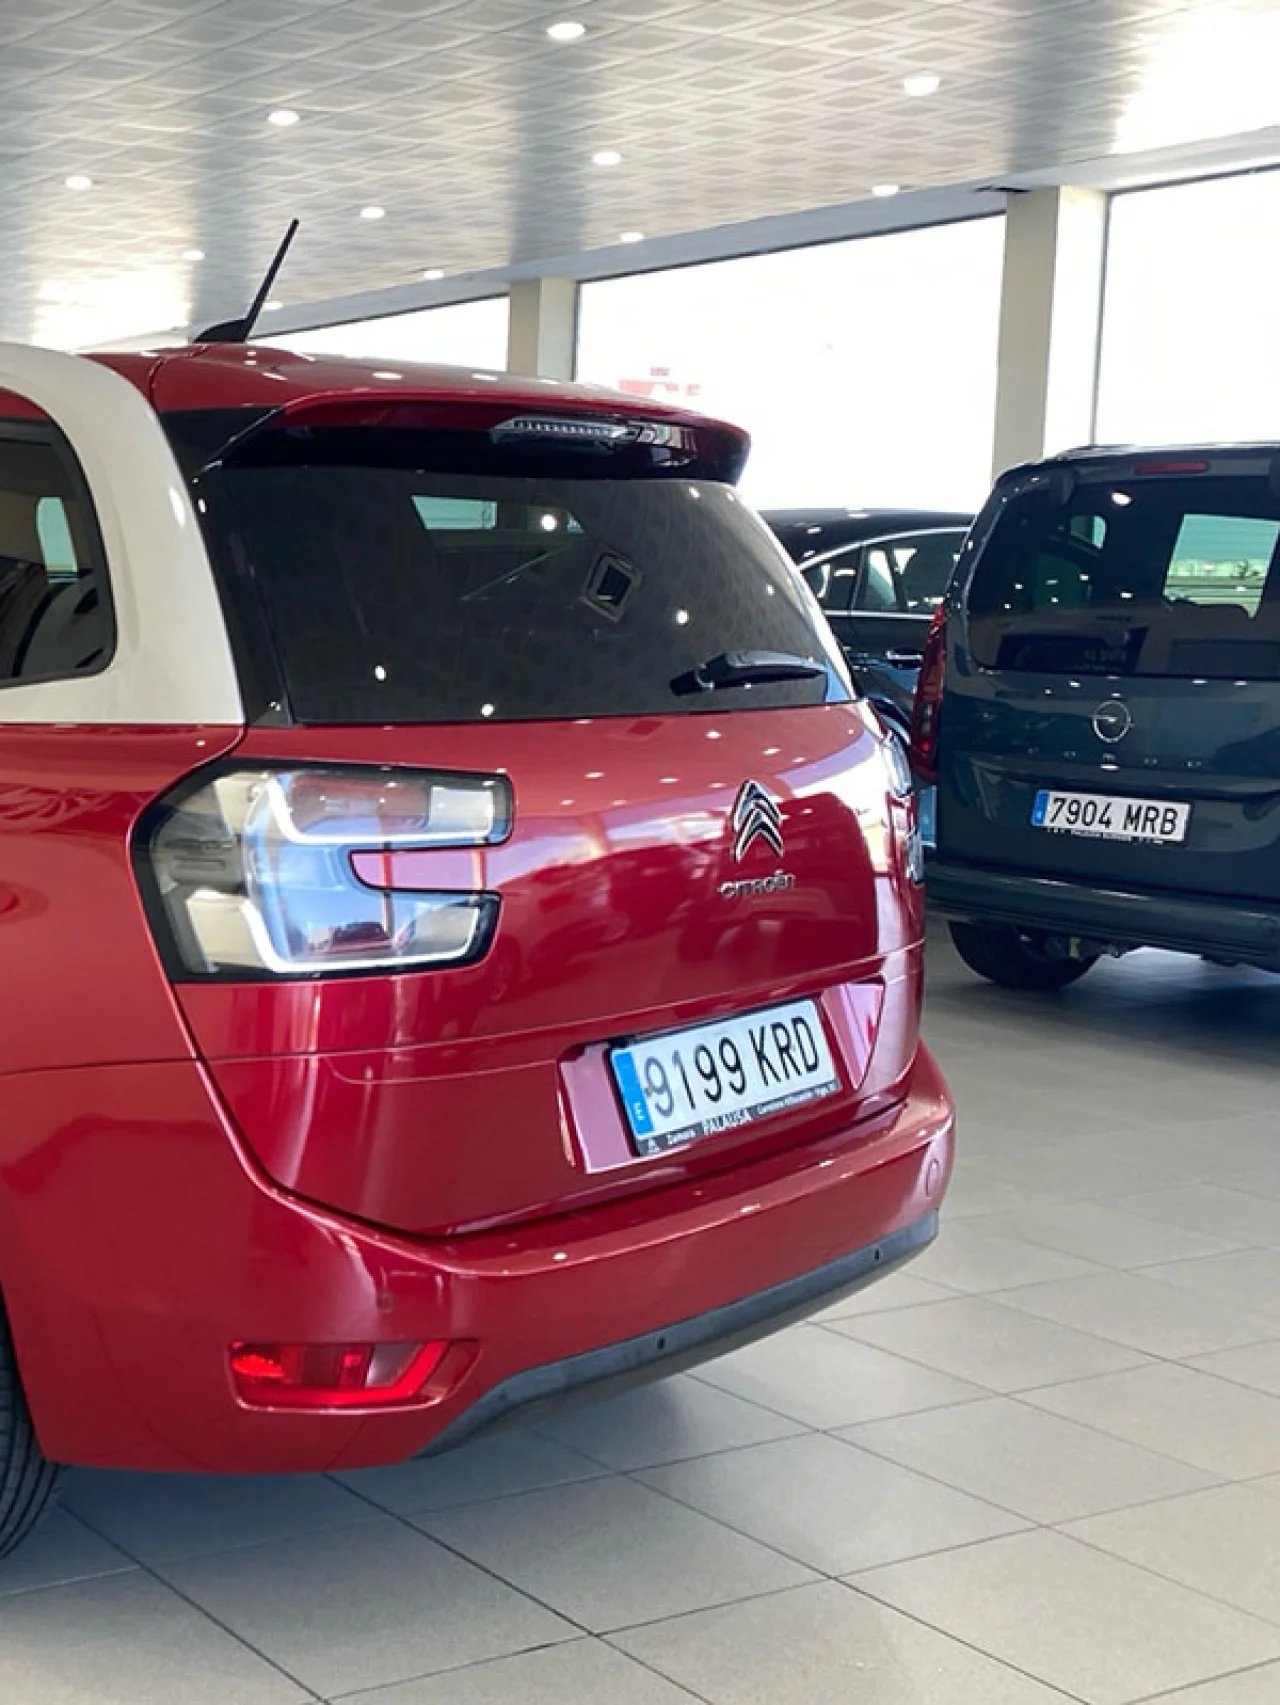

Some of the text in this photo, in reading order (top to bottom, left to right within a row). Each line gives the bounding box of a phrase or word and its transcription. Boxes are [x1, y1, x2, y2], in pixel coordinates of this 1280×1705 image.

[1050, 797, 1178, 835] 7904 MRB
[643, 1036, 746, 1117] 9199
[749, 1016, 820, 1086] KRD
